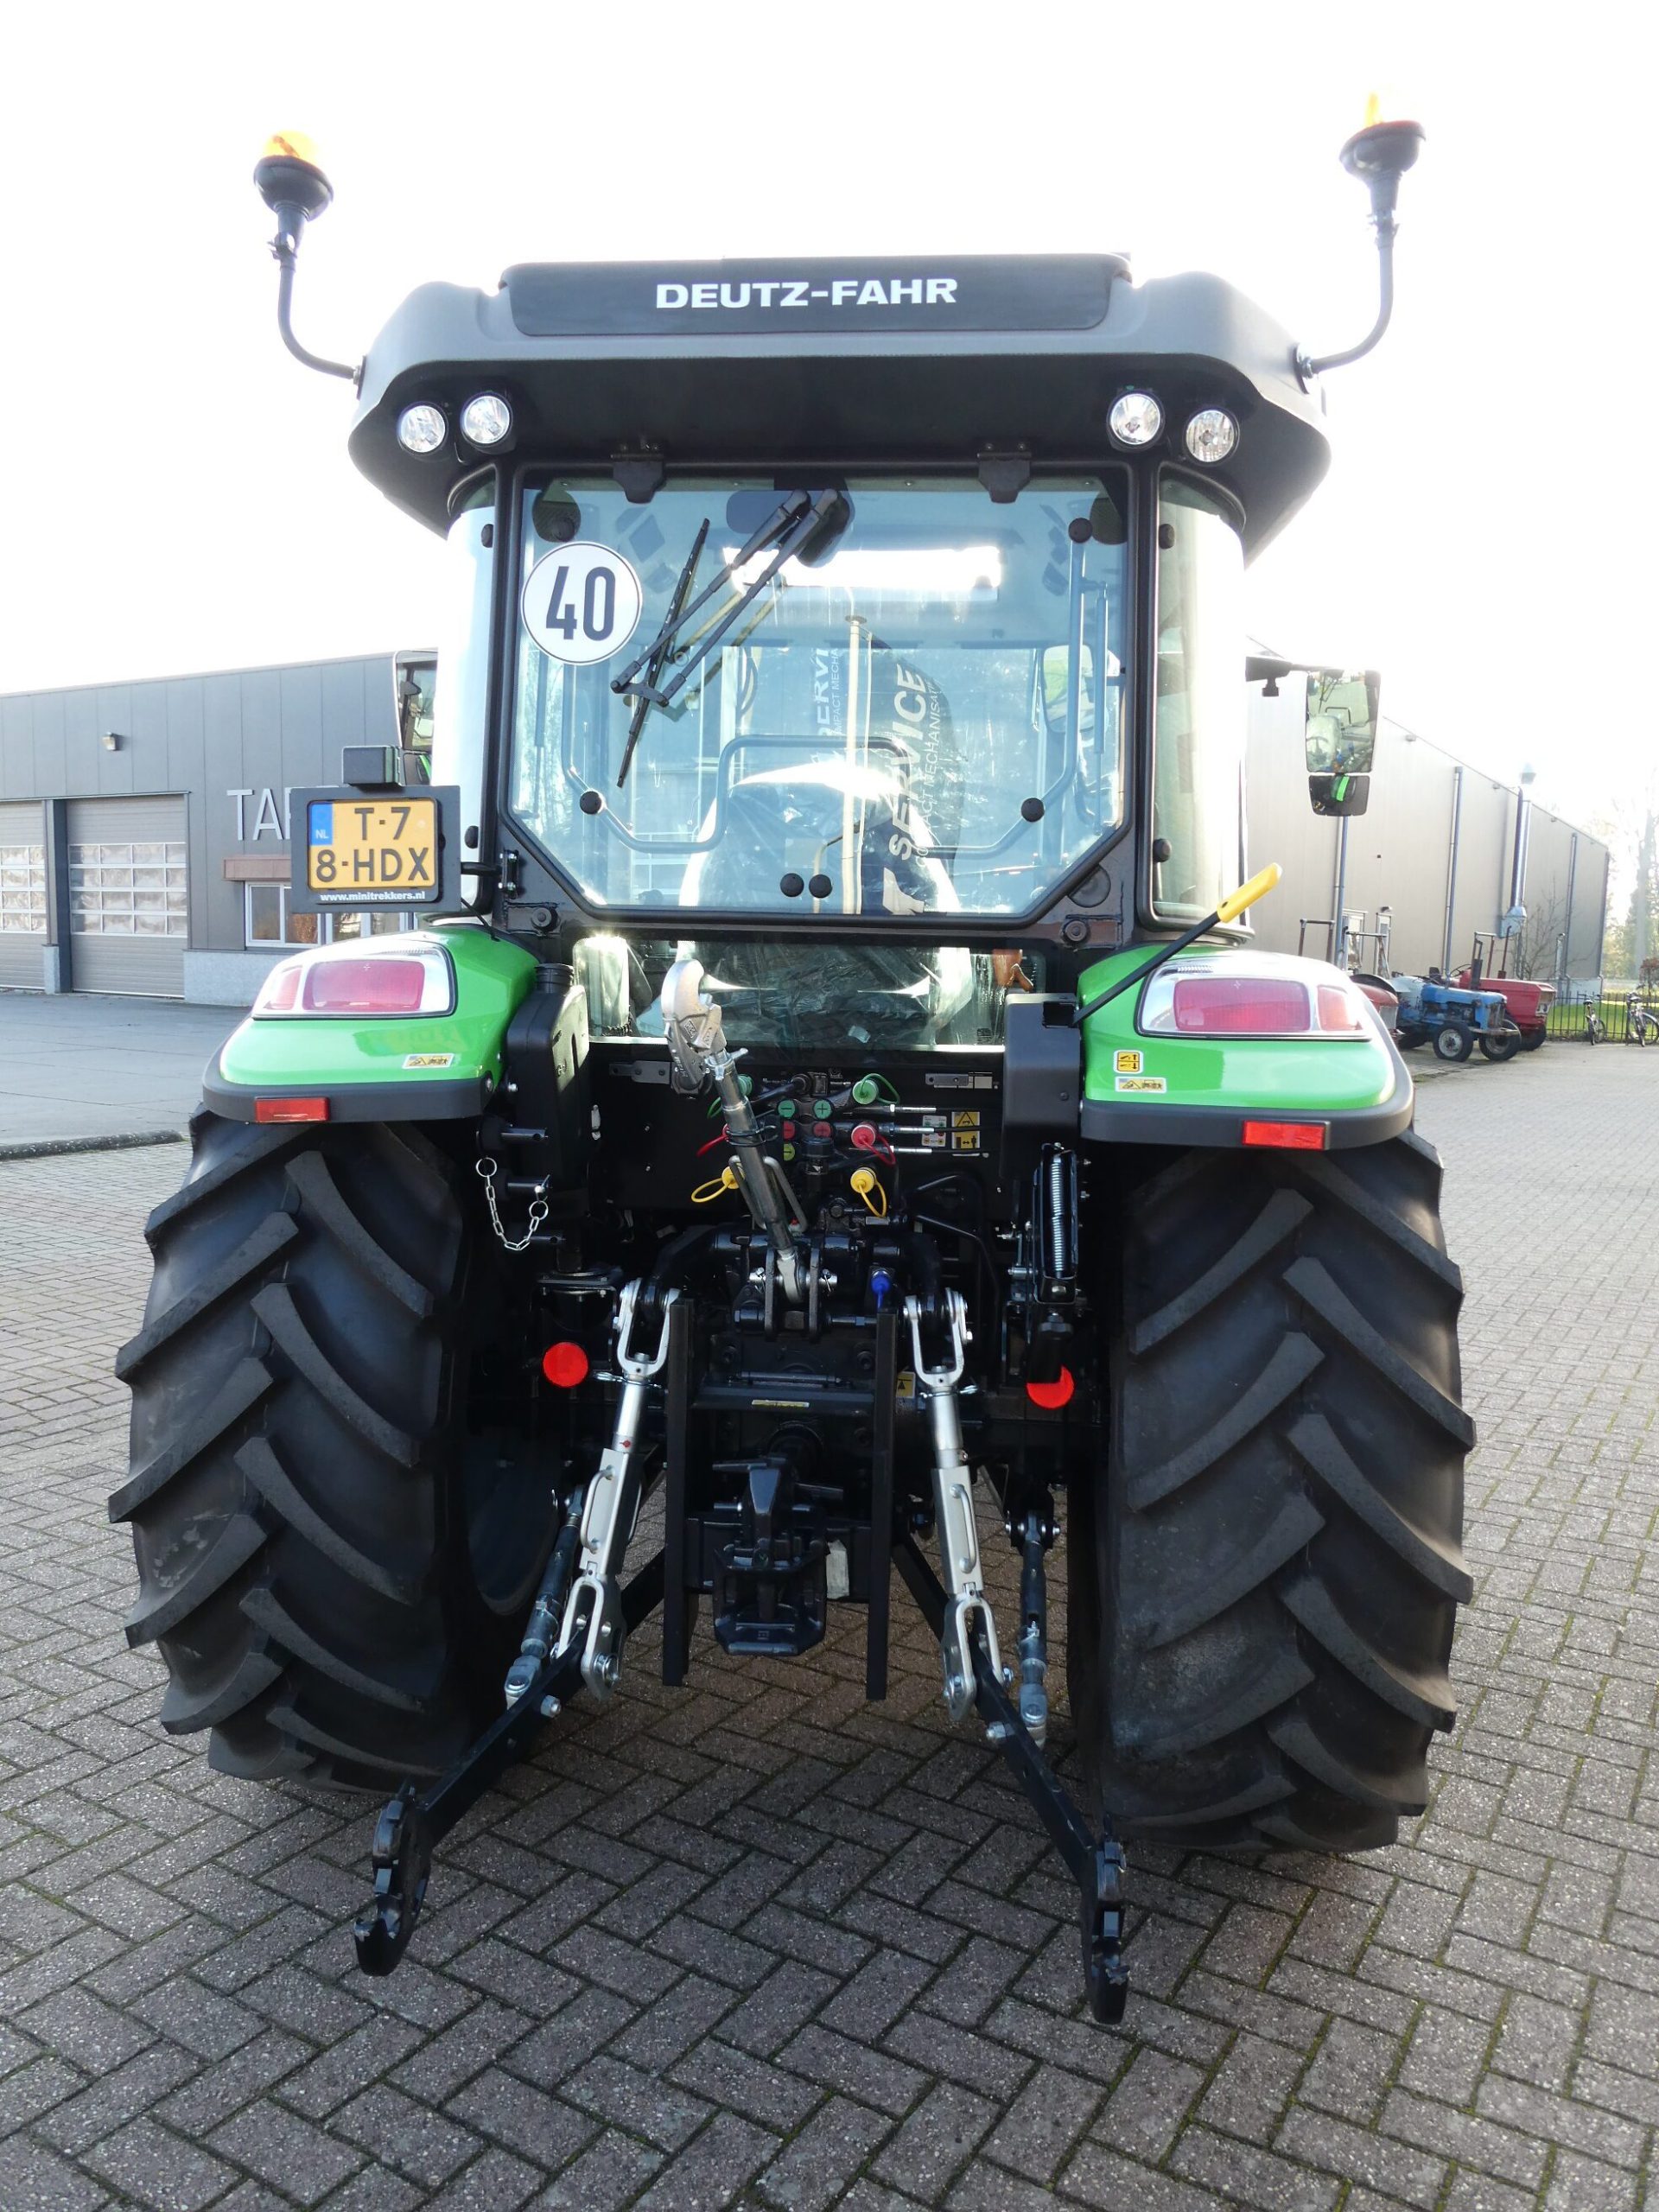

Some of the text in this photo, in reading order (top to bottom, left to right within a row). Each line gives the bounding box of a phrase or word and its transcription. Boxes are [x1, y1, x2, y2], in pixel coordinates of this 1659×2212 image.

[657, 278, 958, 308] DEUTZ-FAHR
[545, 566, 616, 642] 40
[889, 663, 926, 861] SERVICE
[315, 829, 329, 839] NL
[354, 806, 411, 841] T-7
[315, 847, 429, 883] 8-HDX
[320, 891, 426, 901] www.minitrekkers.nl
